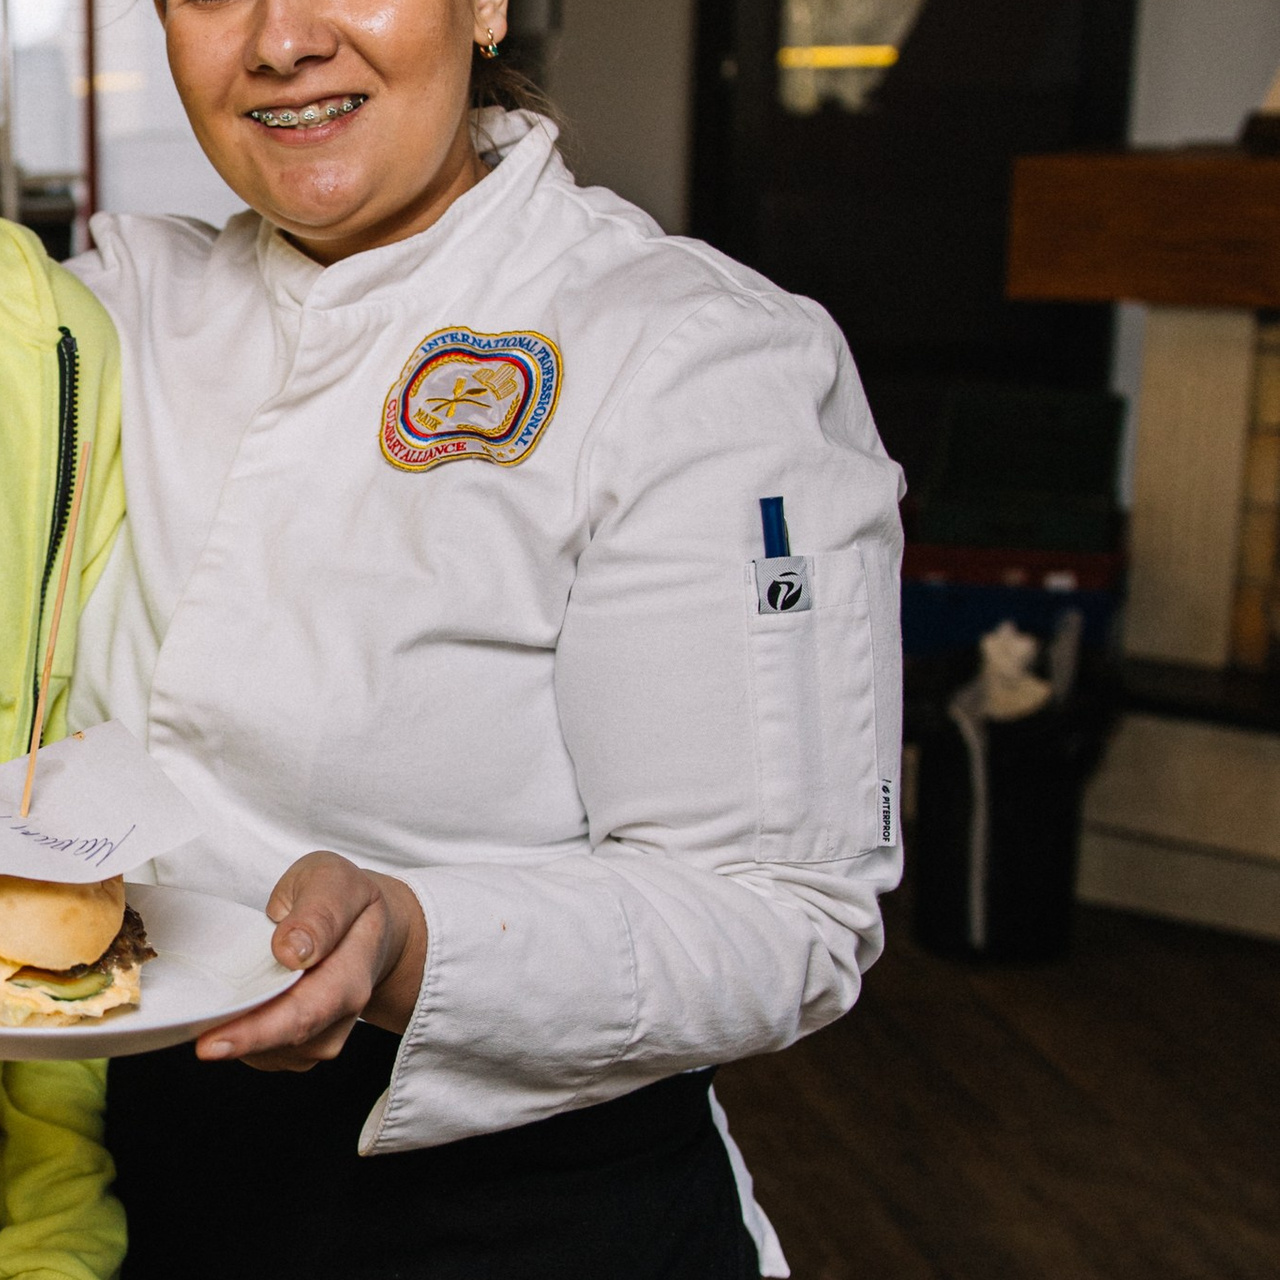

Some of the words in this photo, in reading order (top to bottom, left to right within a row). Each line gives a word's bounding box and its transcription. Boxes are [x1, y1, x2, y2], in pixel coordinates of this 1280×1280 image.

[420, 332, 539, 354] INTERNATIONAL
[514, 346, 554, 447] PROFESSIONAL
[385, 399, 407, 457] CULINARY
[399, 441, 467, 463] ALLIANCE
[882, 796, 891, 843] PITERPROF
